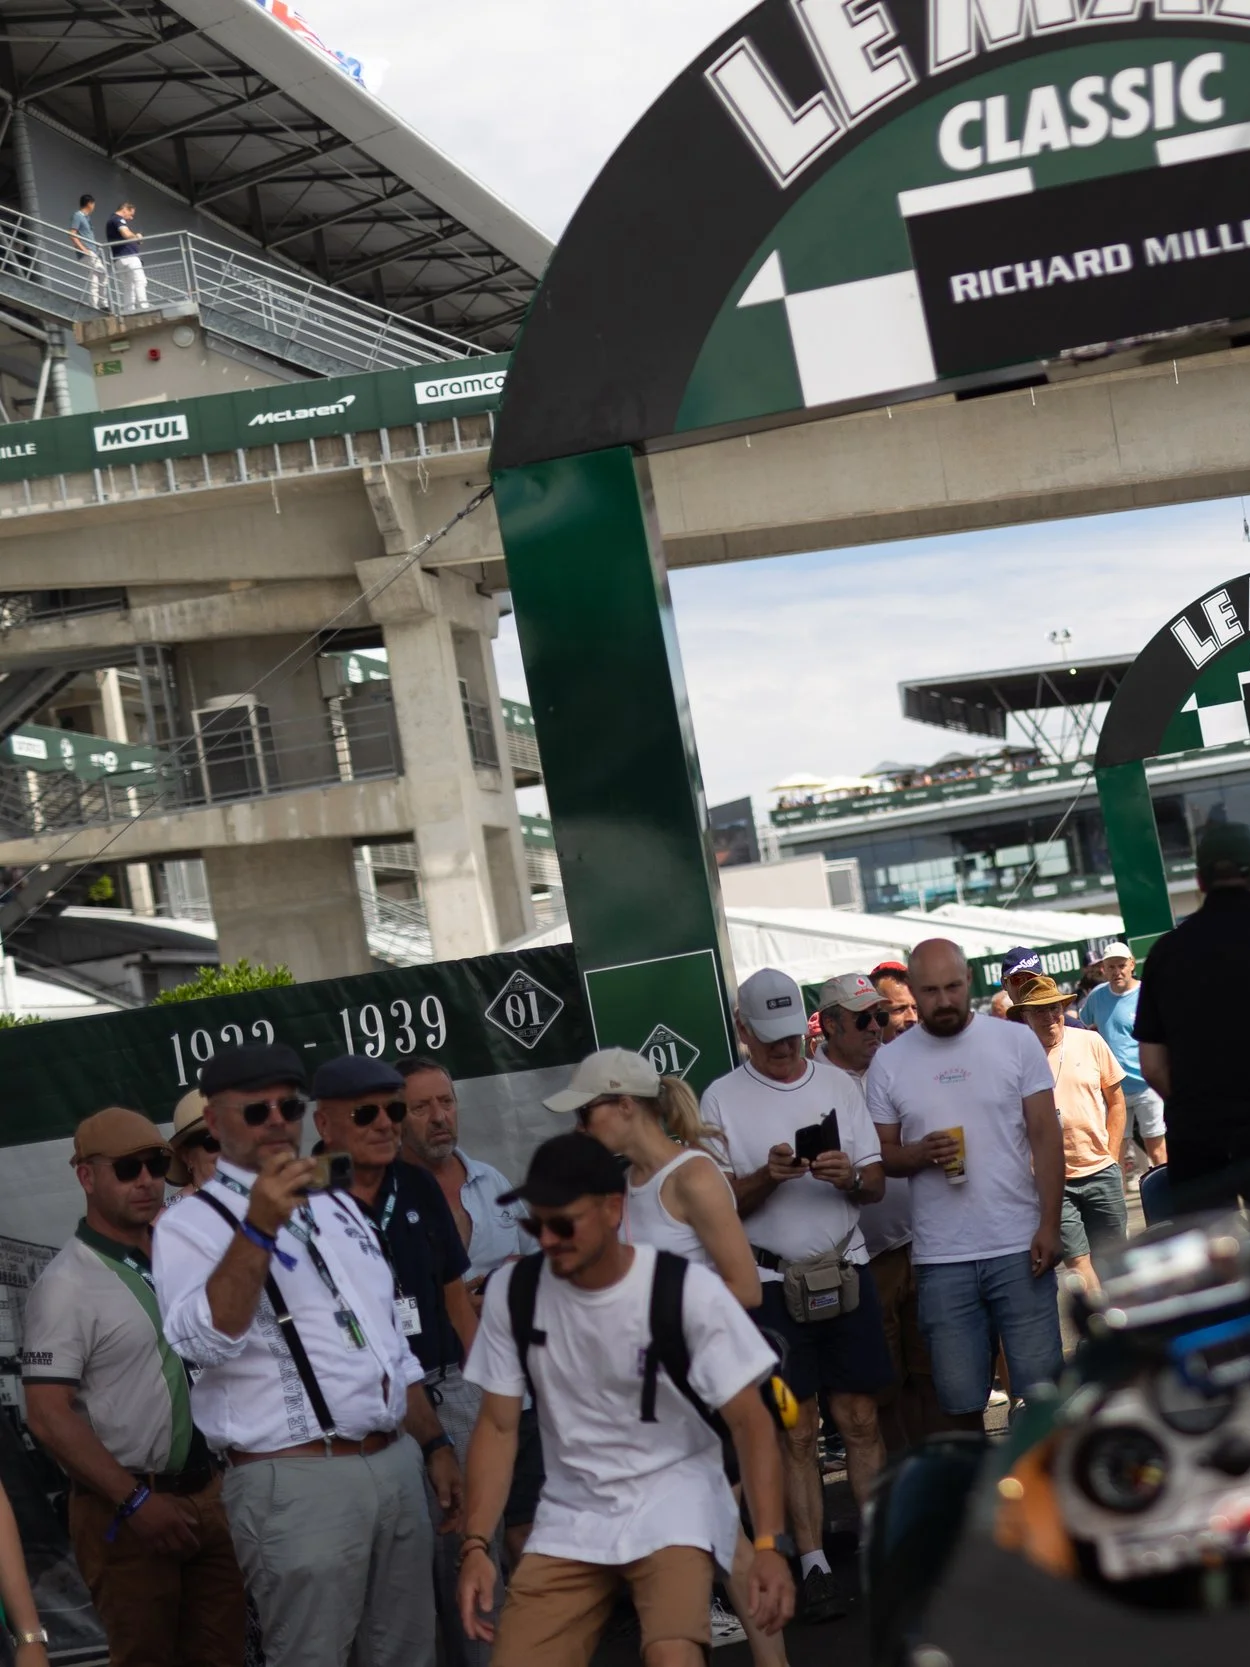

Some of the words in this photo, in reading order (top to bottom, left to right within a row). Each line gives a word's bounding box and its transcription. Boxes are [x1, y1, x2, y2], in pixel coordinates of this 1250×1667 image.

[704, 0, 918, 187] LE
[938, 53, 1223, 170] CLASSIC
[950, 242, 1133, 303] RICHARD
[0, 442, 37, 460] ILLE
[102, 420, 182, 447] MOTUL
[1170, 589, 1245, 670] LE
[339, 995, 447, 1059] 1939
[505, 990, 545, 1028] 01
